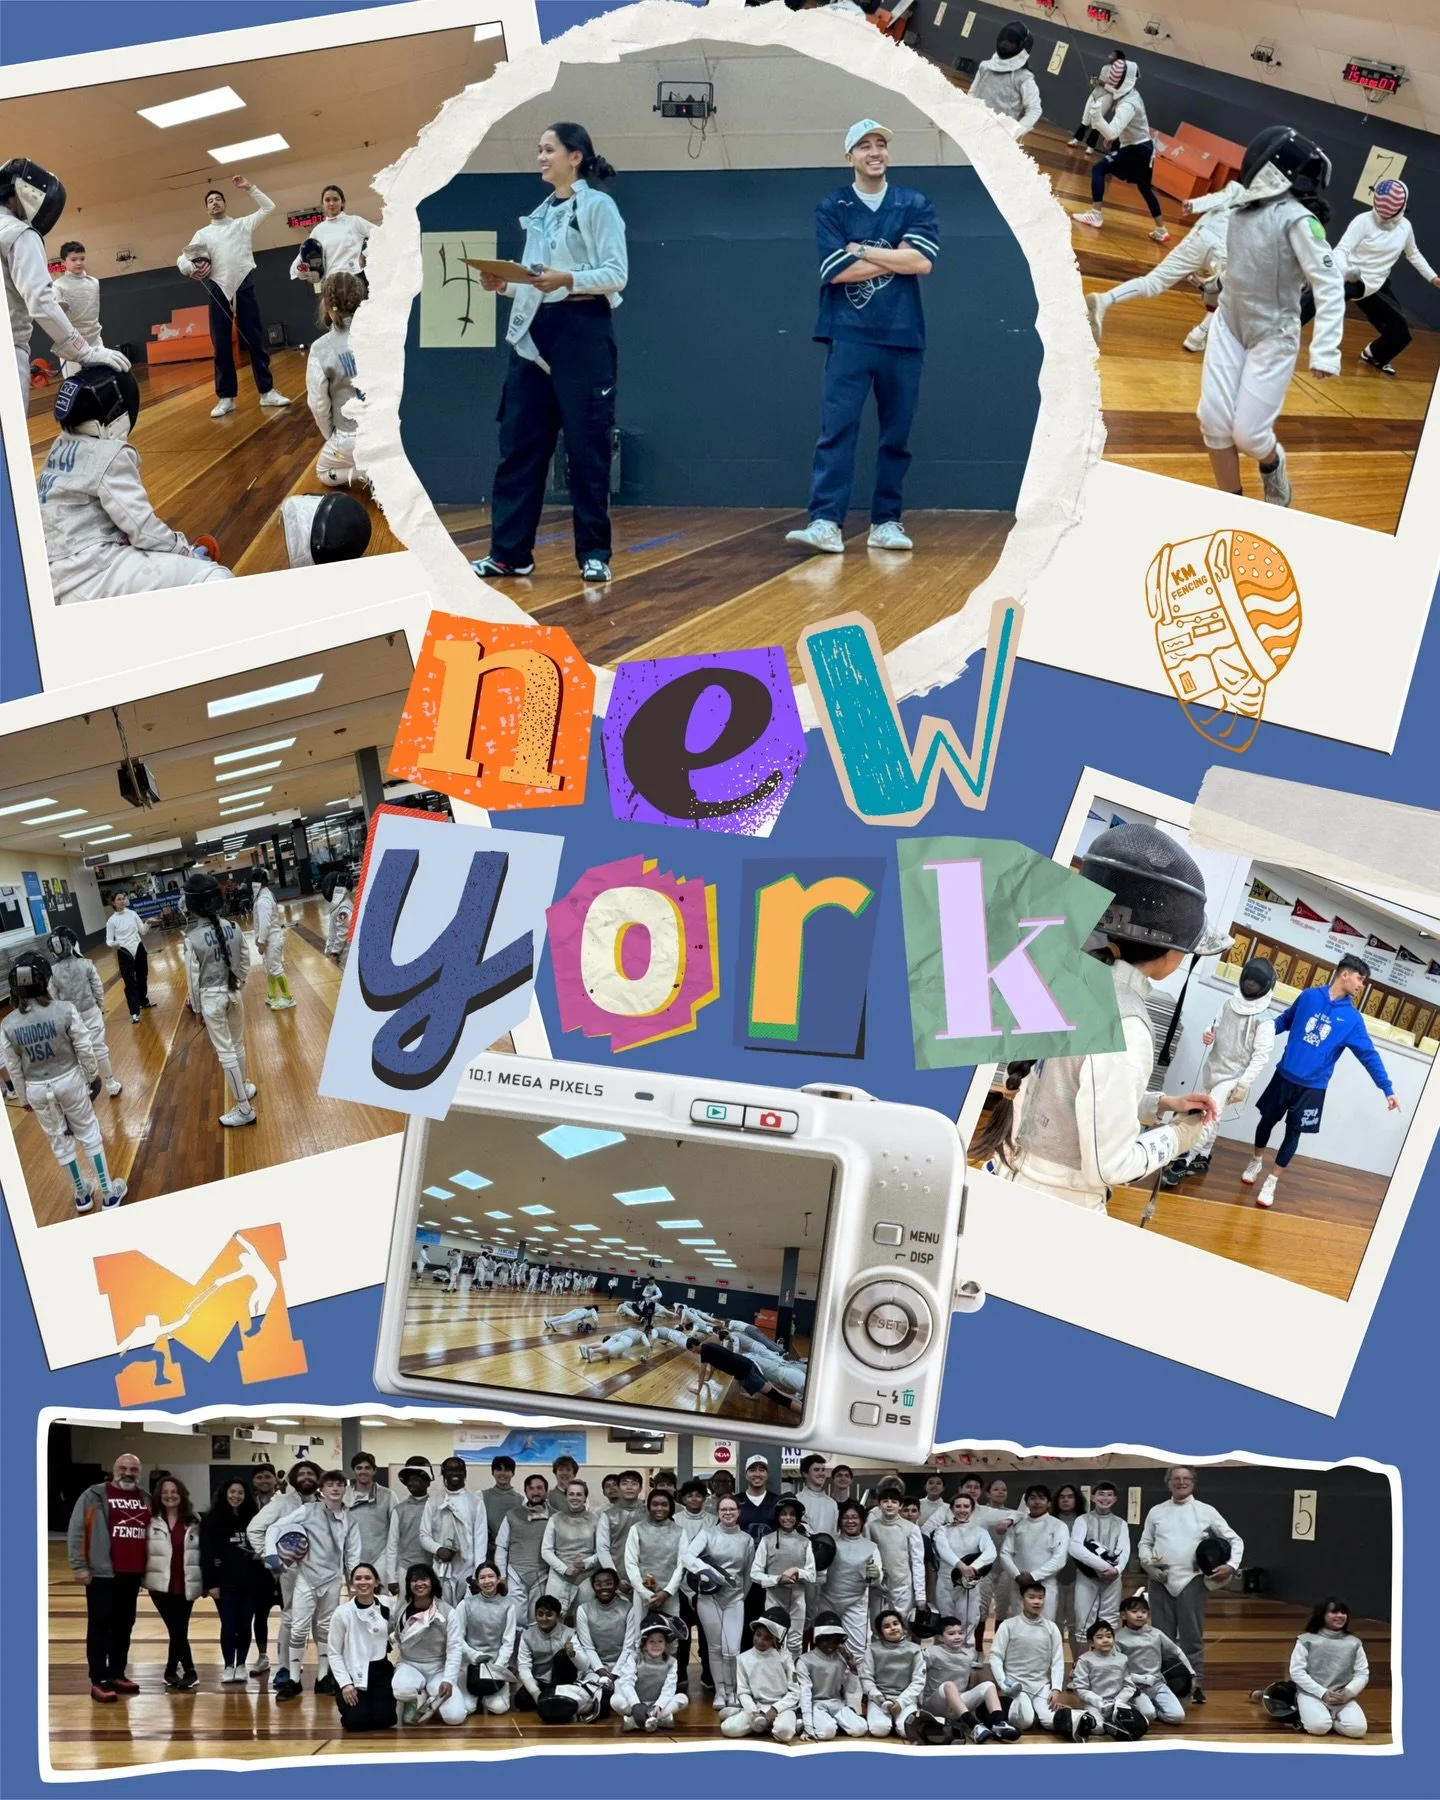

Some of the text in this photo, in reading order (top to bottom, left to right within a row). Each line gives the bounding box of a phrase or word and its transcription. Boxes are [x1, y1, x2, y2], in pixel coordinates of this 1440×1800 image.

[1368, 153, 1394, 196] 7
[439, 240, 479, 337] 4
[14, 1020, 57, 1046] WHIDDON
[25, 1041, 55, 1063] USA
[469, 1068, 604, 1097] 10.1 MEGA PIXELS
[909, 1230, 940, 1244] MENU
[910, 1253, 935, 1265] DISP
[877, 1318, 901, 1331] SET
[885, 1413, 912, 1426] BS
[108, 1498, 149, 1510] TEMPL
[1295, 1494, 1312, 1536] 5
